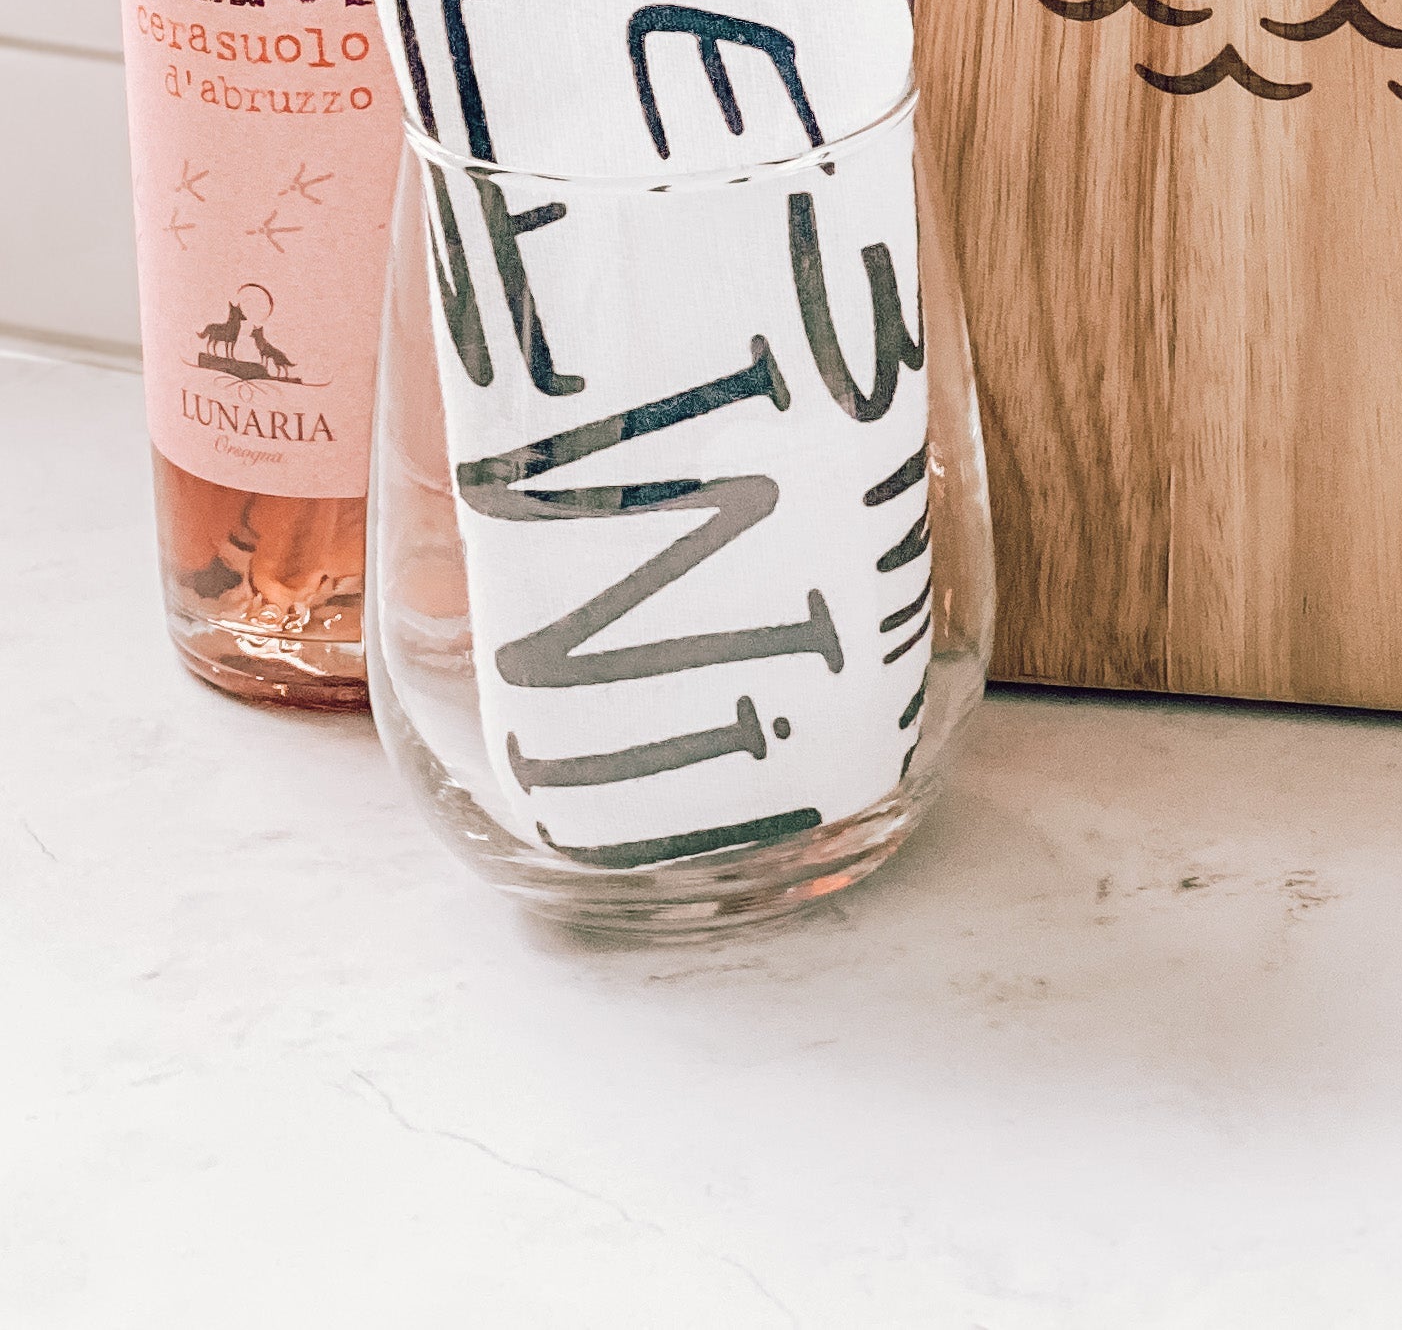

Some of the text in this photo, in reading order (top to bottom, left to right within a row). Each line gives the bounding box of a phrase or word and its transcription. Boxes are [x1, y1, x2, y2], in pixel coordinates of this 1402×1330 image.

[137, 4, 370, 68] cerasuolo
[164, 64, 373, 114] d'abruzzo
[181, 388, 338, 442] LUNARIA
